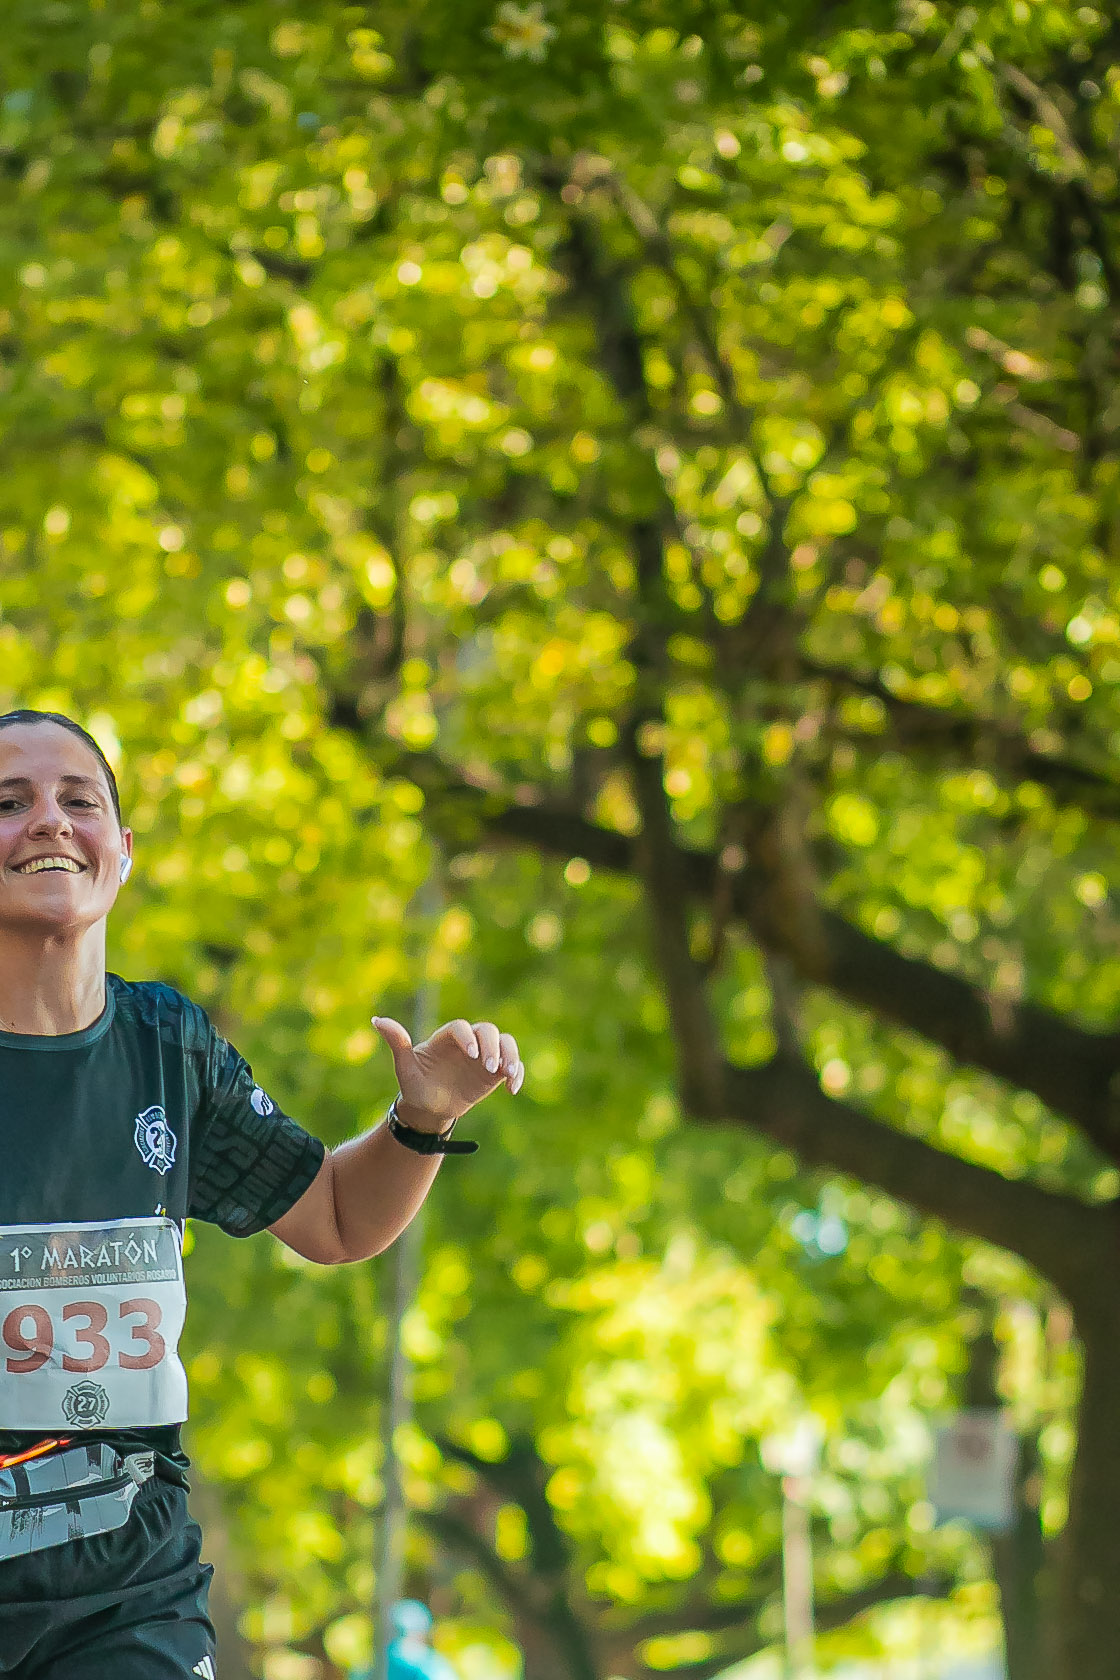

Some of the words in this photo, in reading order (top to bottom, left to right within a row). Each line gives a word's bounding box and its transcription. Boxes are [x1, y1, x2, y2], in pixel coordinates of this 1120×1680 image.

[41, 1232, 158, 1270] MARATÓN
[43, 1275, 90, 1287] BOMBEROS
[91, 1271, 146, 1285] VOLUNTARIOS
[146, 1268, 177, 1281] ROSARIO
[2, 1298, 167, 1374] 933
[77, 1395, 97, 1412] 27
